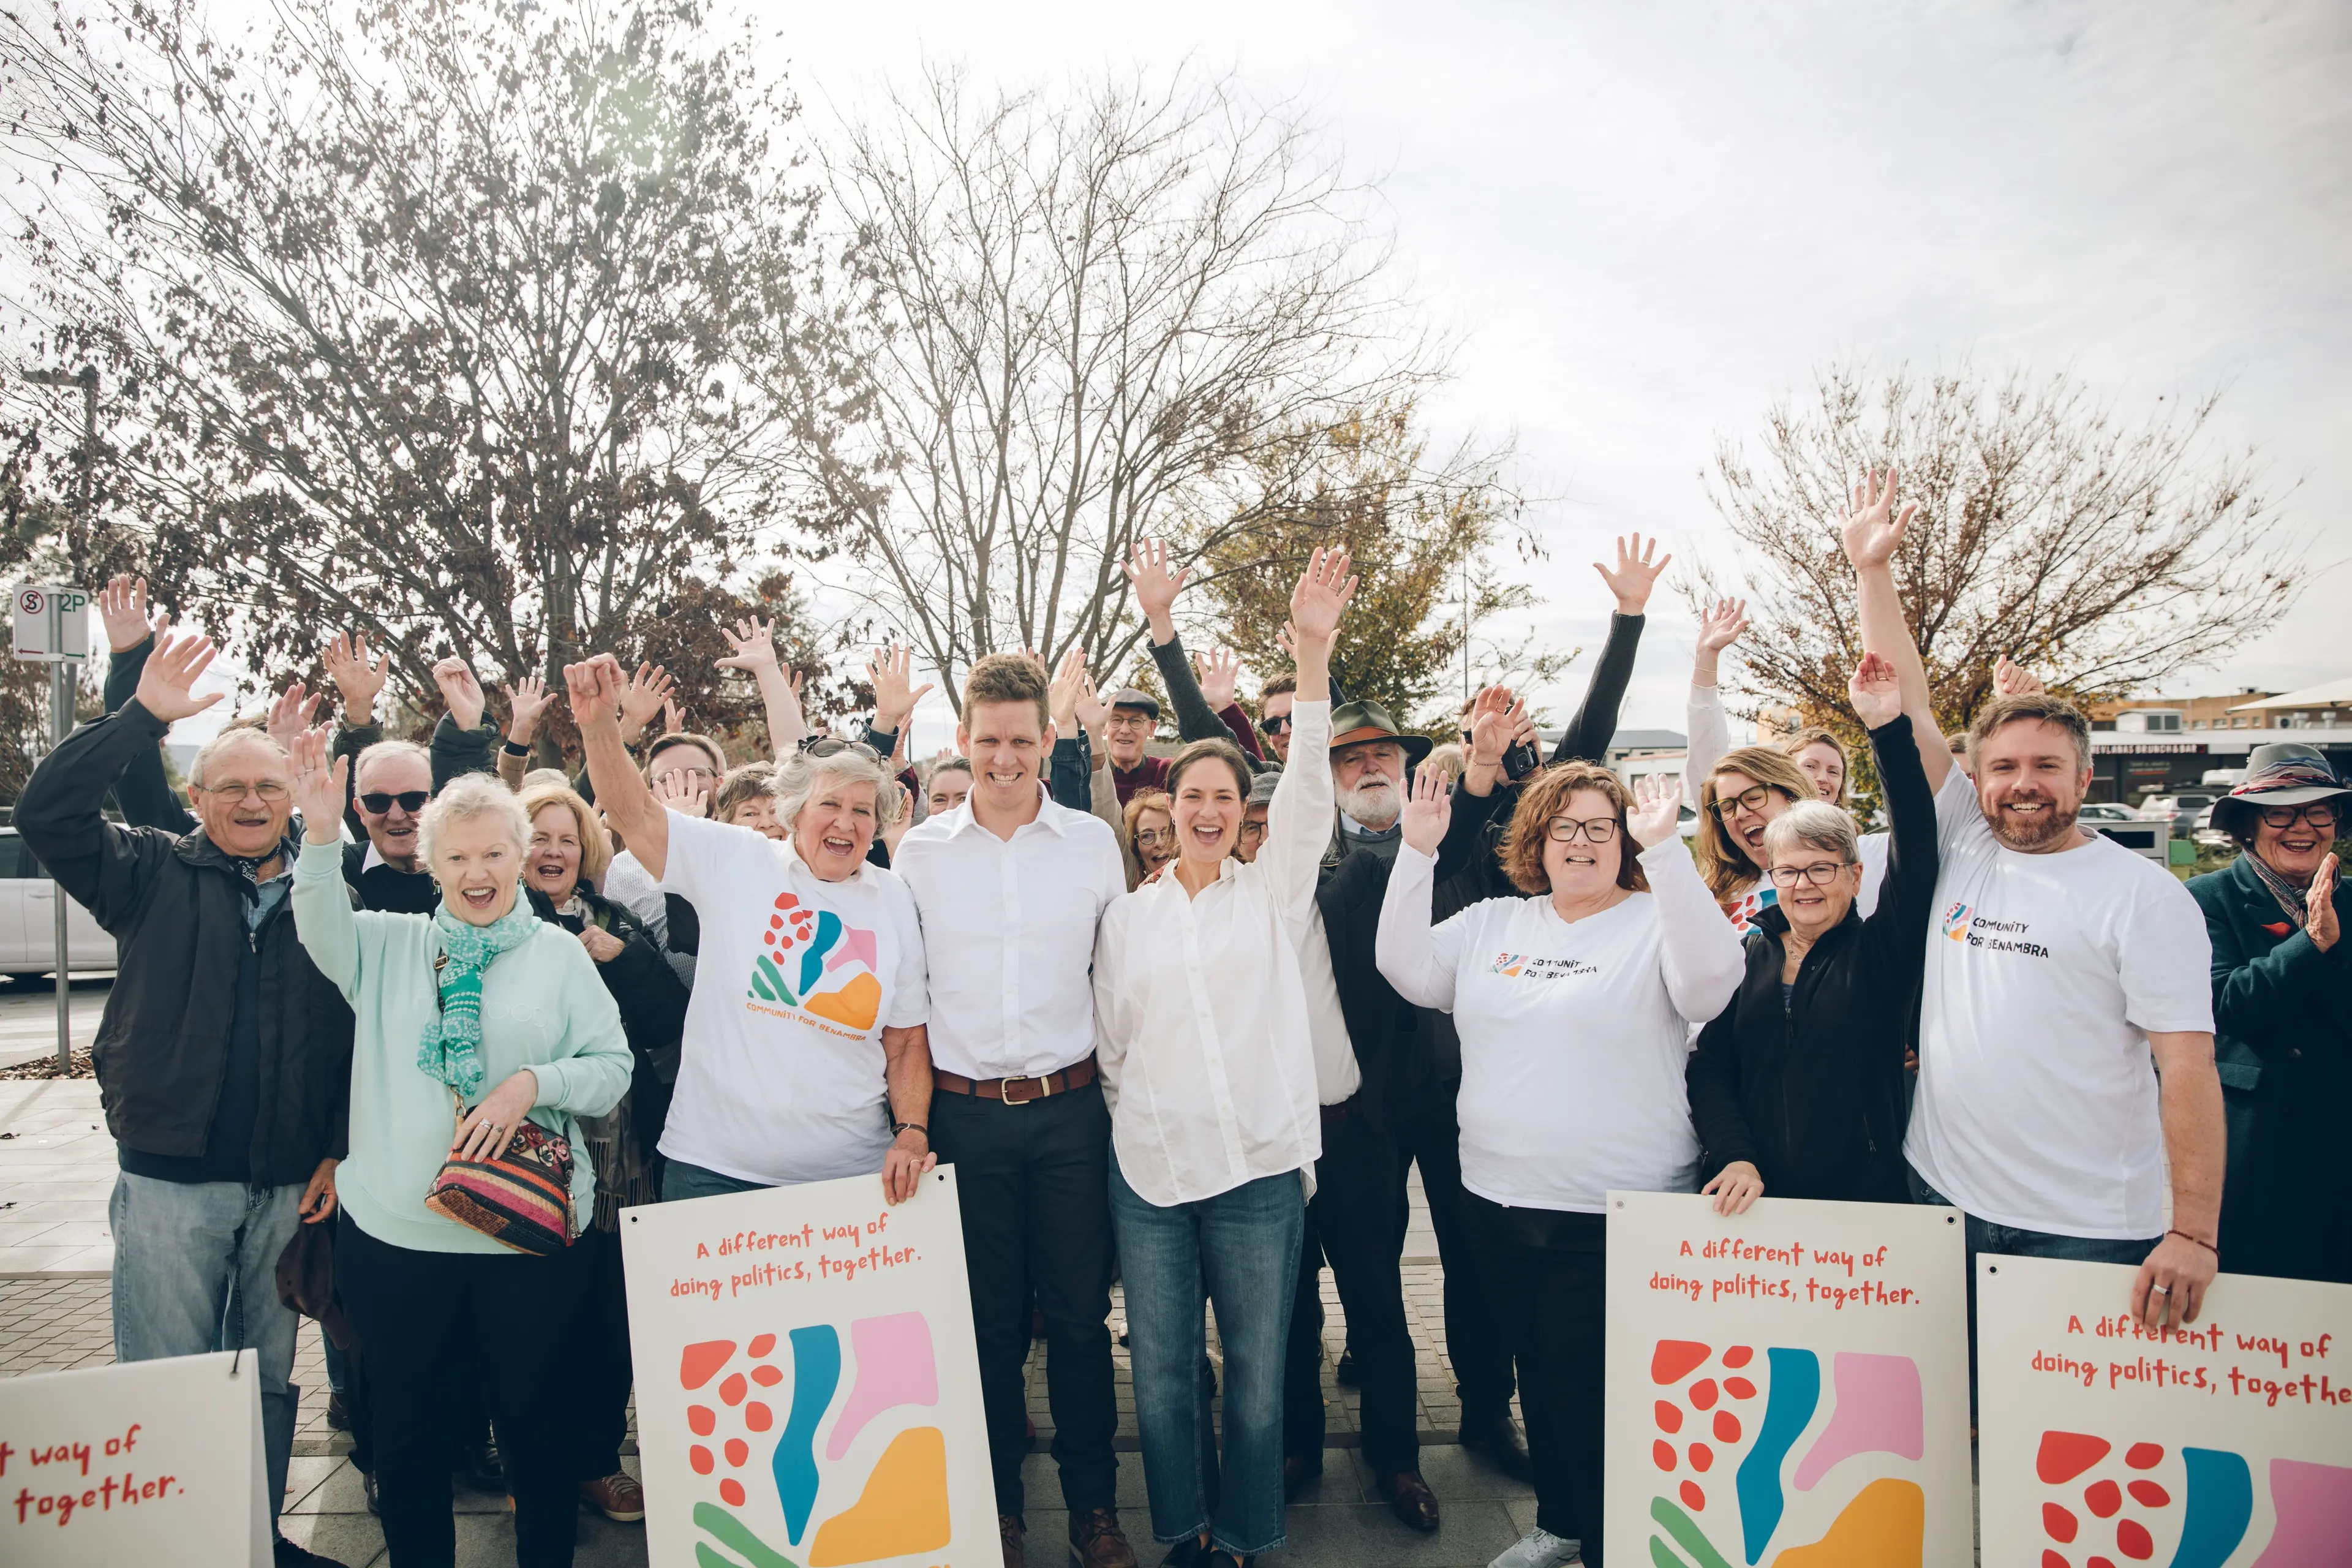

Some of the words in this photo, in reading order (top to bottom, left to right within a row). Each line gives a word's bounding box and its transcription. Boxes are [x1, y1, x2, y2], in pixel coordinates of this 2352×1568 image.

[61, 594, 85, 612] 2P
[1966, 932, 1985, 948] FOR
[1988, 938, 2049, 958] BENAMBRA
[798, 1016, 816, 1027] FOR
[819, 1023, 867, 1041] BENAMBRA
[696, 1243, 710, 1259] A
[718, 1224, 813, 1256] different
[823, 1224, 860, 1248] way
[867, 1212, 889, 1234] of
[1679, 1240, 1693, 1256] A
[1702, 1237, 1805, 1267] different
[1814, 1250, 1854, 1278] way
[1862, 1245, 1888, 1267] of
[670, 1278, 722, 1301] doing
[731, 1261, 811, 1297] politics,
[818, 1245, 922, 1281] together.
[1649, 1271, 1703, 1302] doing
[1712, 1273, 1796, 1303] politics,
[1805, 1277, 1920, 1310] together.
[2067, 1314, 2084, 1334] A
[2236, 1334, 2288, 1369] way
[2300, 1333, 2332, 1358] of
[2030, 1350, 2098, 1387] doing
[2109, 1355, 2217, 1395] politics,
[2227, 1365, 2352, 1408] togethe
[31, 1442, 91, 1477] way
[105, 1423, 141, 1456] of
[15, 1472, 184, 1526] together.
